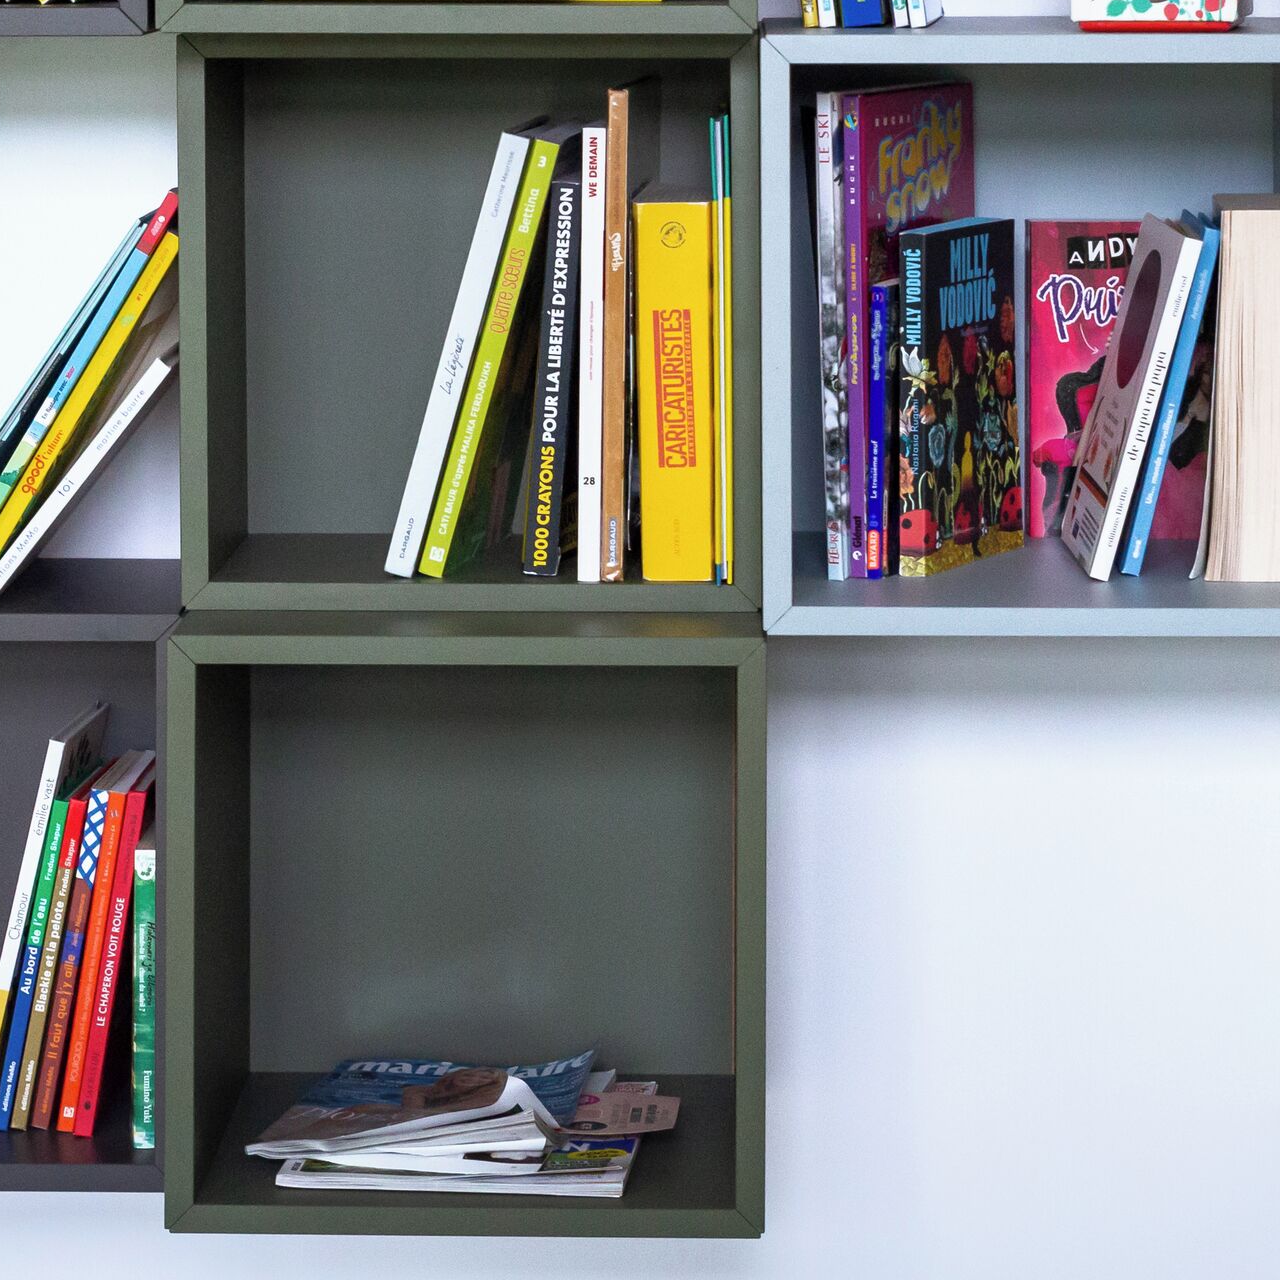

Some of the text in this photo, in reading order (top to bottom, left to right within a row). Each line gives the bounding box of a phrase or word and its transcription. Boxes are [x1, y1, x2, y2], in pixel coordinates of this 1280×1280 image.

[817, 114, 830, 164] LE SKI
[588, 136, 599, 198] WE DEMAIN
[518, 188, 541, 234] Bettina
[950, 232, 990, 284] MILLY
[903, 248, 922, 345] MILLY VODOVIĆ
[939, 267, 998, 332] VODOVIĆ
[439, 381, 452, 396] La
[533, 187, 574, 568] 1000 CRAYONS POUR LA LIBERTÉ D'EXPRESSION
[1135, 350, 1167, 443] papa papa
[96, 420, 122, 452] martine
[439, 361, 492, 536] CATI BAUR d'après MALIKA FERDJOUKH
[910, 398, 920, 475] Nastasia Rugani
[21, 453, 45, 496] good
[57, 478, 75, 497] toi
[583, 477, 596, 486] 28
[16, 525, 40, 553] MeMo
[399, 517, 416, 559] DARGAUD
[609, 519, 617, 564] DARGAUD
[852, 515, 862, 548] Glénat
[868, 531, 879, 568] BAYARD
[36, 777, 55, 837] émilie vast
[44, 822, 62, 882] Fredun Shapur
[59, 837, 76, 897] Fredun Shapur
[9, 892, 30, 941] Chamour
[21, 897, 48, 995] Au bord de l'eau
[34, 900, 65, 1013] Blackie et la pelote
[96, 897, 126, 1027] LE CHAPERON VOIT ROUGE
[46, 952, 76, 1059] Il faut que aille
[2, 1060, 17, 1112] éditions MeMo
[143, 1069, 152, 1124] Fumino Yuki
